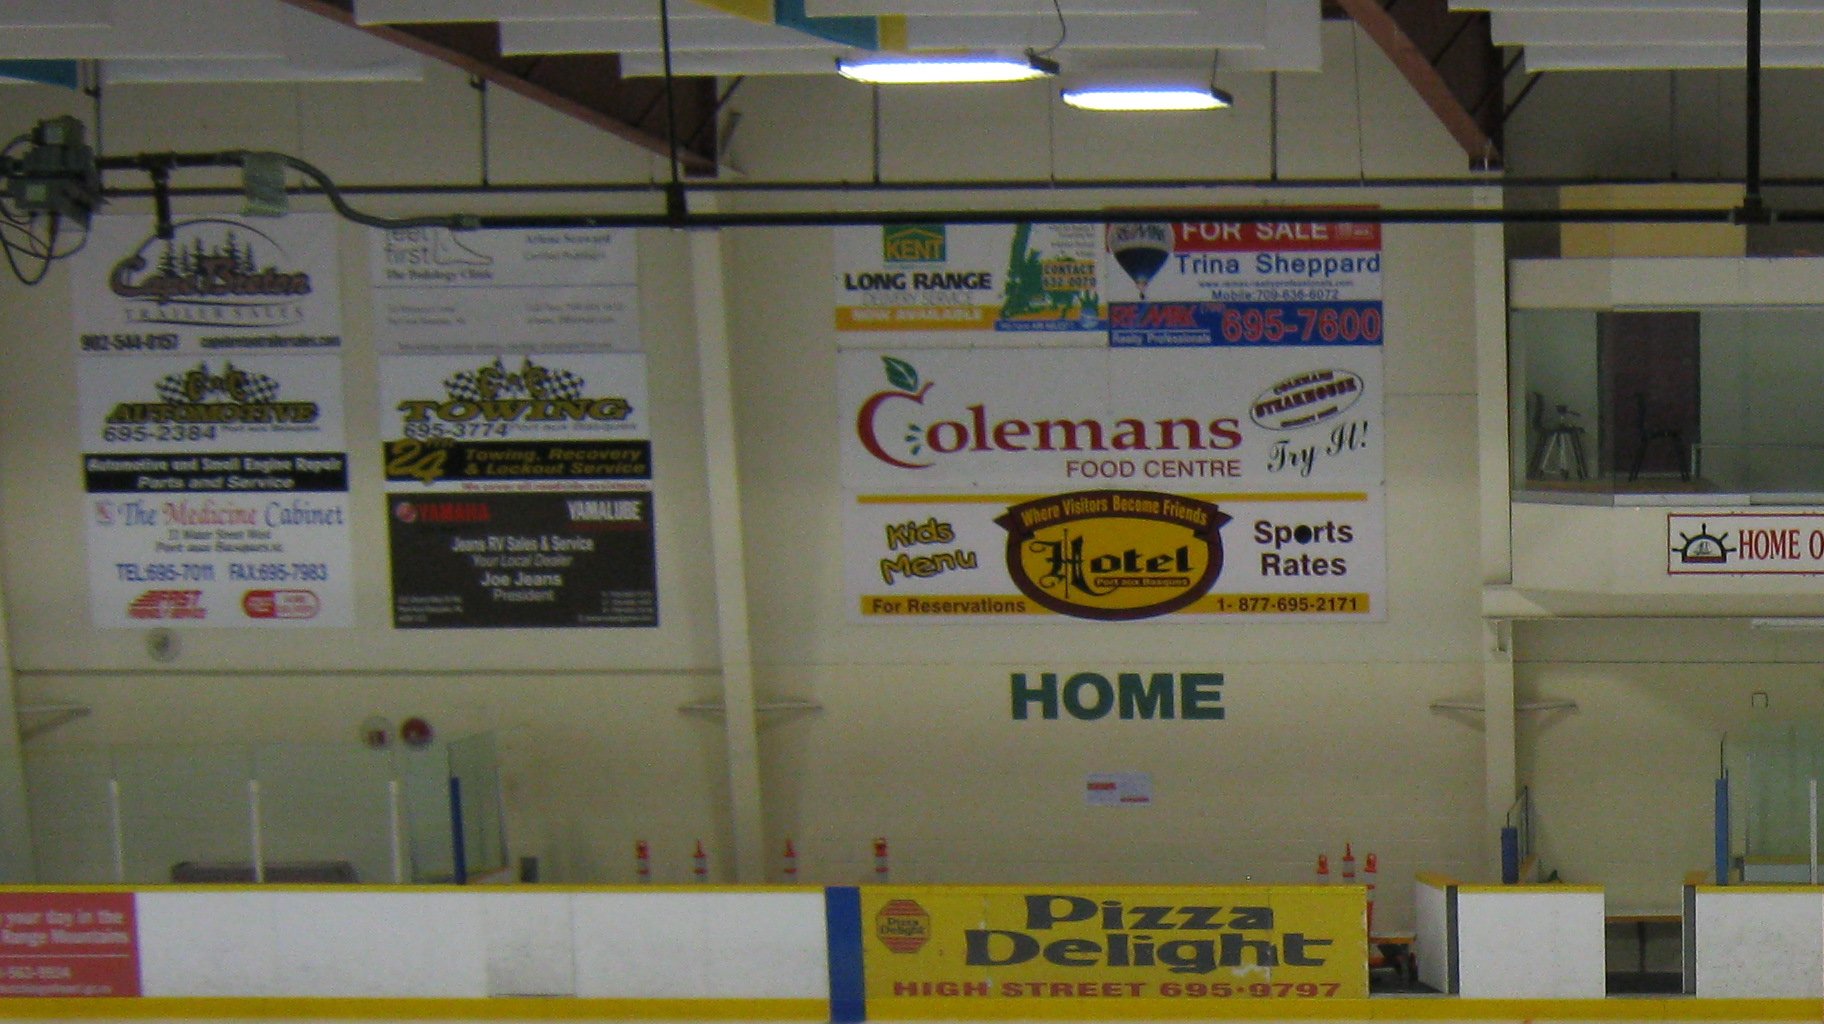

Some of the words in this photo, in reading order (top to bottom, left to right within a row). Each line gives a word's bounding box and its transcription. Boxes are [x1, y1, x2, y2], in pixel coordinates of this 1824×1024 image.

[1182, 223, 1242, 241] FOR
[1255, 223, 1329, 241] SALE
[885, 238, 944, 260] KENT
[1174, 254, 1240, 275] Trina
[1255, 253, 1381, 278] Sheppard
[844, 272, 906, 291] LONG
[912, 272, 993, 291] RANGE
[1221, 308, 1381, 342] 695-7600
[104, 402, 320, 424] AUTOMOTIVE
[397, 398, 635, 422] TOWING
[103, 425, 216, 442] 695-2384
[403, 422, 507, 440] 695-3774
[856, 381, 1244, 470] Colemans
[387, 437, 449, 485] 24
[549, 449, 642, 463] Recovery
[1267, 440, 1315, 478] Try
[487, 462, 565, 476] Lockout
[570, 462, 647, 476] Service
[1066, 460, 1136, 478] FOOD
[1144, 460, 1242, 478] CENTRE
[137, 476, 186, 489] Parts
[188, 476, 225, 489] and
[226, 476, 295, 489] Service
[163, 500, 256, 526] Medicine
[264, 500, 345, 528] Cabinet
[418, 502, 491, 522] YAMAHA
[1020, 503, 1060, 527] Where
[1062, 498, 1108, 515] Visitors
[1112, 495, 1160, 514] Become
[1162, 500, 1208, 526] Friends
[506, 536, 539, 551] Sales
[550, 536, 595, 551] Service
[886, 517, 956, 550] Kids
[1253, 519, 1354, 549] Sports
[1738, 529, 1800, 560] HOME
[472, 555, 500, 567] Your
[502, 555, 534, 567] Local
[535, 555, 575, 567] Dealer
[880, 550, 978, 585] Menu
[1029, 530, 1195, 597] Hotel
[1260, 552, 1348, 576] Rates
[481, 573, 511, 587] Joe
[515, 573, 563, 587] Jeans
[872, 599, 901, 613] For
[907, 599, 1026, 614] Reservations
[1010, 672, 1225, 720] HOME
[888, 917, 919, 925] Pizza
[1024, 894, 1275, 931] Pizza
[964, 929, 1335, 974] Delight
[893, 982, 988, 998] HIGH
[1000, 982, 1148, 998] STREET
